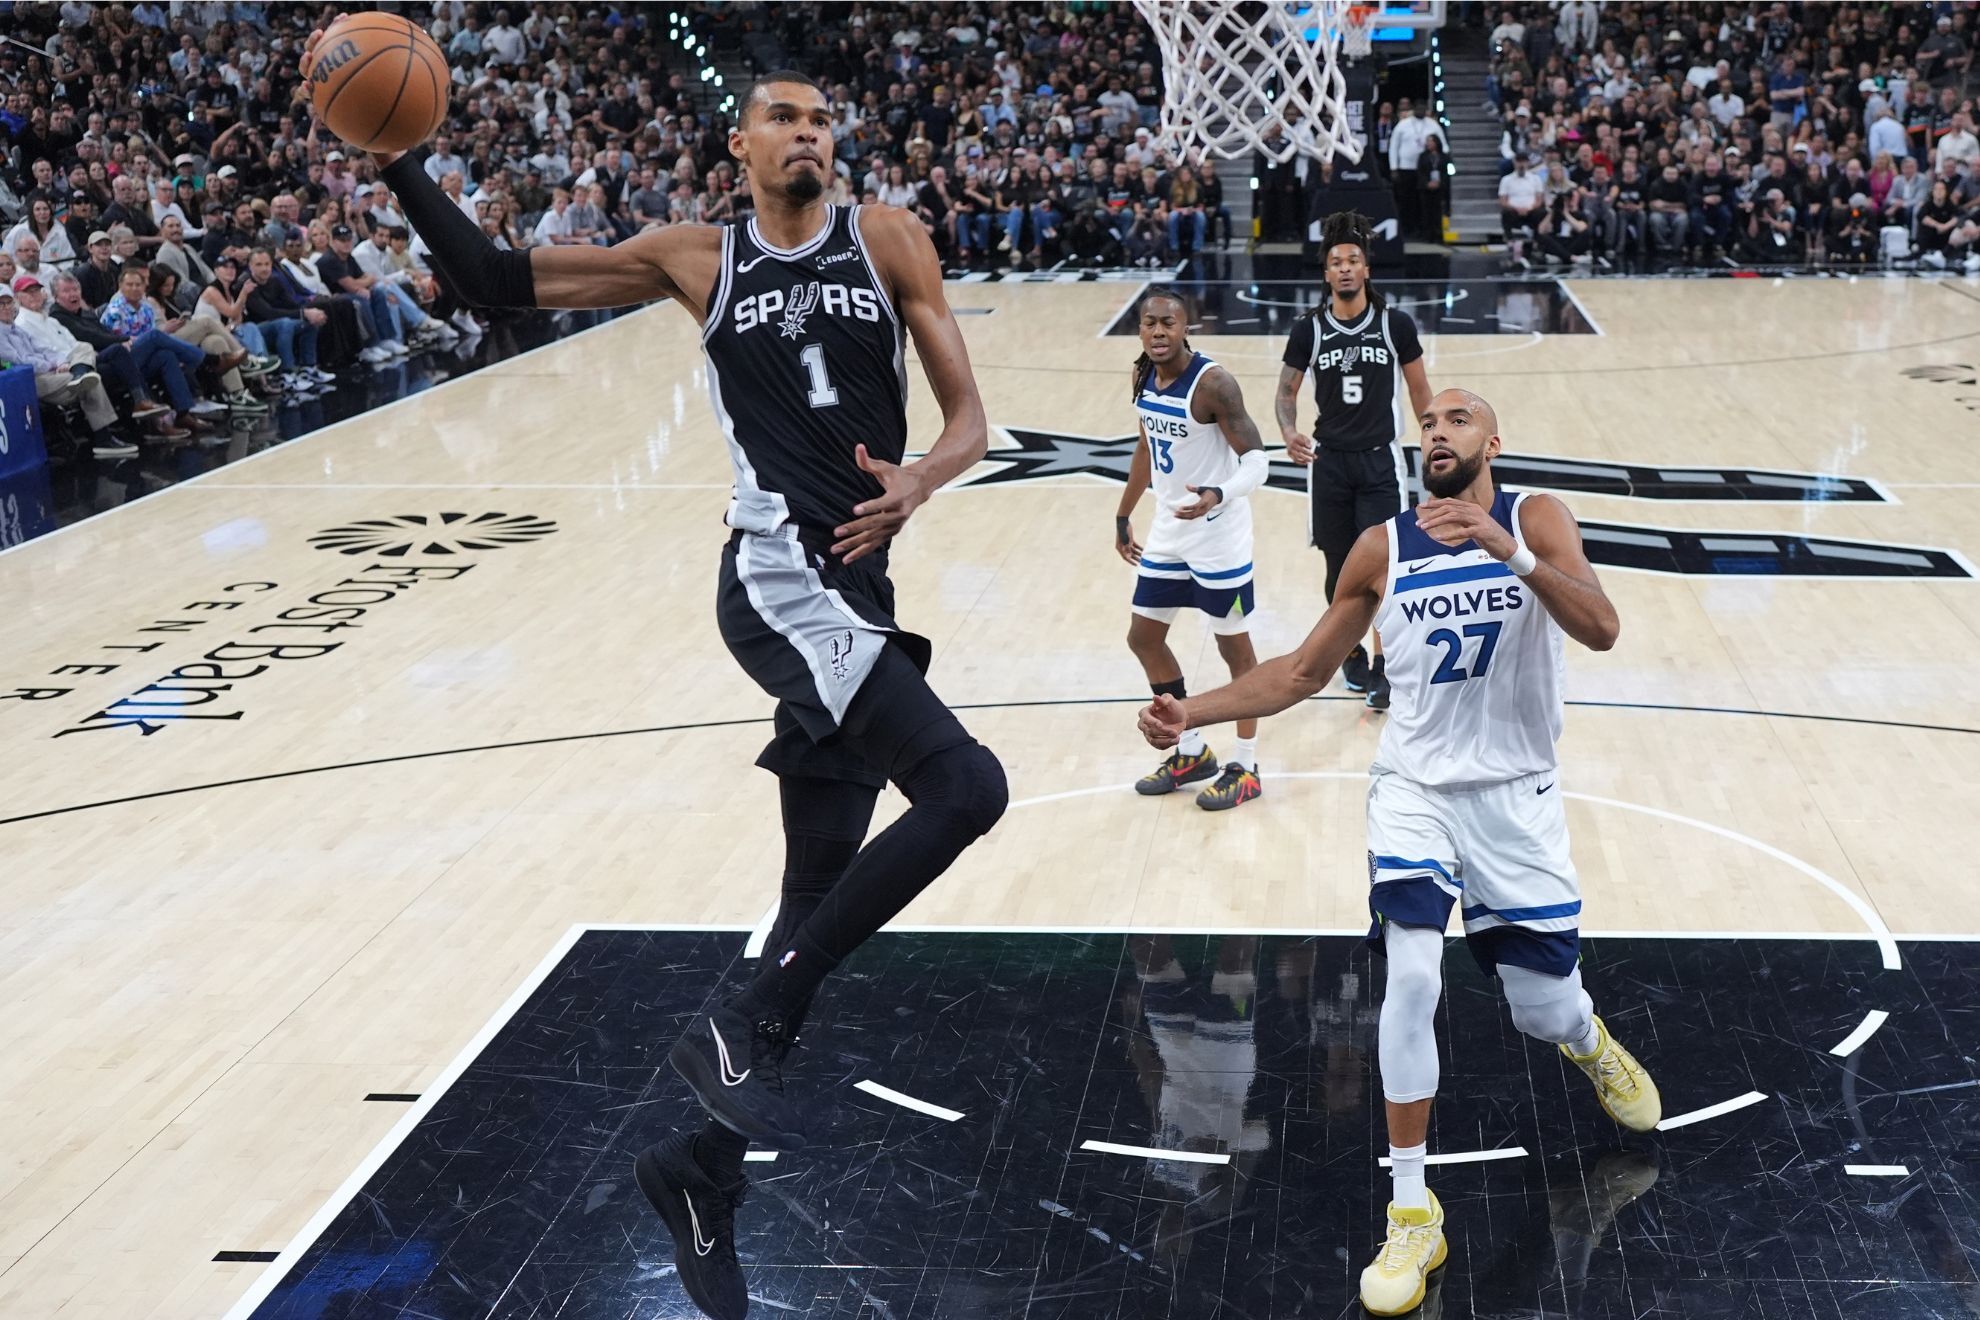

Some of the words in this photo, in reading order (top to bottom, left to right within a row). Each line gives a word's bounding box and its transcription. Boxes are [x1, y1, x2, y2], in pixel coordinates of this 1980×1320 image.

[820, 248, 855, 266] LEDGER
[800, 343, 840, 408] 1
[1342, 375, 1363, 404] 5
[1149, 436, 1174, 474] 13
[247, 563, 478, 633] Frost
[1401, 585, 1523, 624] WOLVES
[0, 582, 279, 701] CENTER
[1425, 621, 1503, 685] 27
[50, 641, 346, 738] Bank
